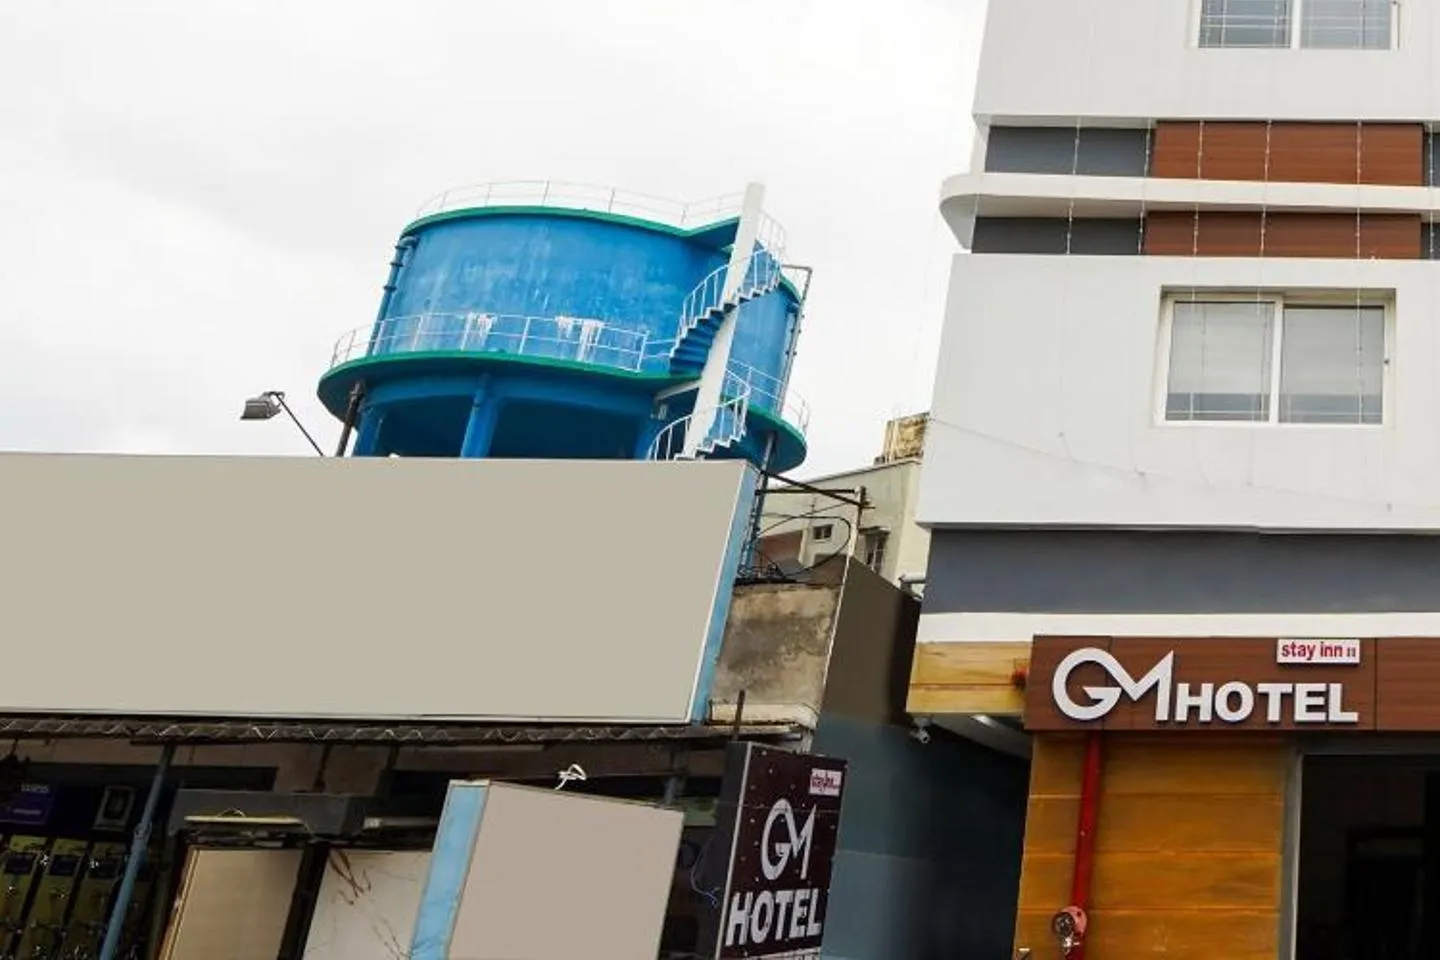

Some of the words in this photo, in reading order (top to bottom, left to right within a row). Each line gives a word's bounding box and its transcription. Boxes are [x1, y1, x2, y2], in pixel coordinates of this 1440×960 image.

[1281, 641, 1316, 661] stay
[1052, 647, 1174, 721] GM
[1175, 681, 1359, 723] HOTEL
[761, 798, 817, 881] GM
[725, 888, 822, 947] HOTEL
